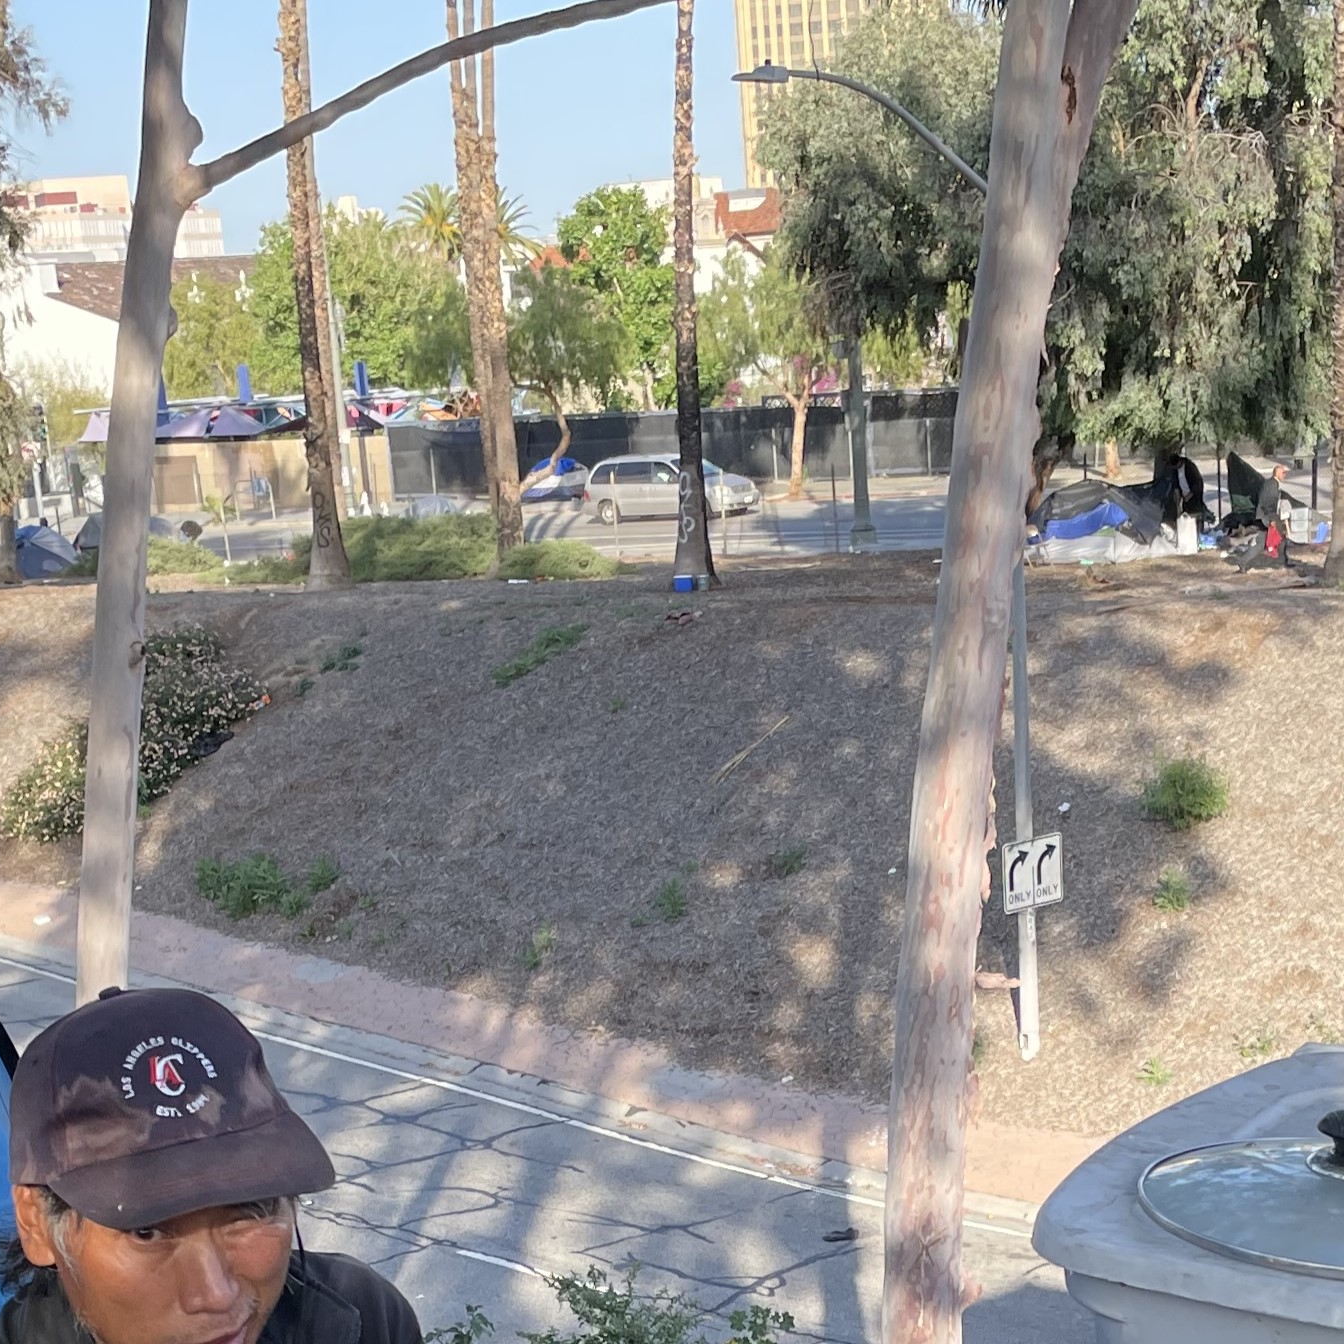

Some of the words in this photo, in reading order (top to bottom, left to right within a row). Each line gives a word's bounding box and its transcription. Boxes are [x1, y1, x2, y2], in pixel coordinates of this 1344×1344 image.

[1008, 890, 1032, 905] ONLY
[1036, 883, 1058, 898] ONLY
[122, 1036, 165, 1071] ANGELES
[120, 1076, 136, 1100] LOS
